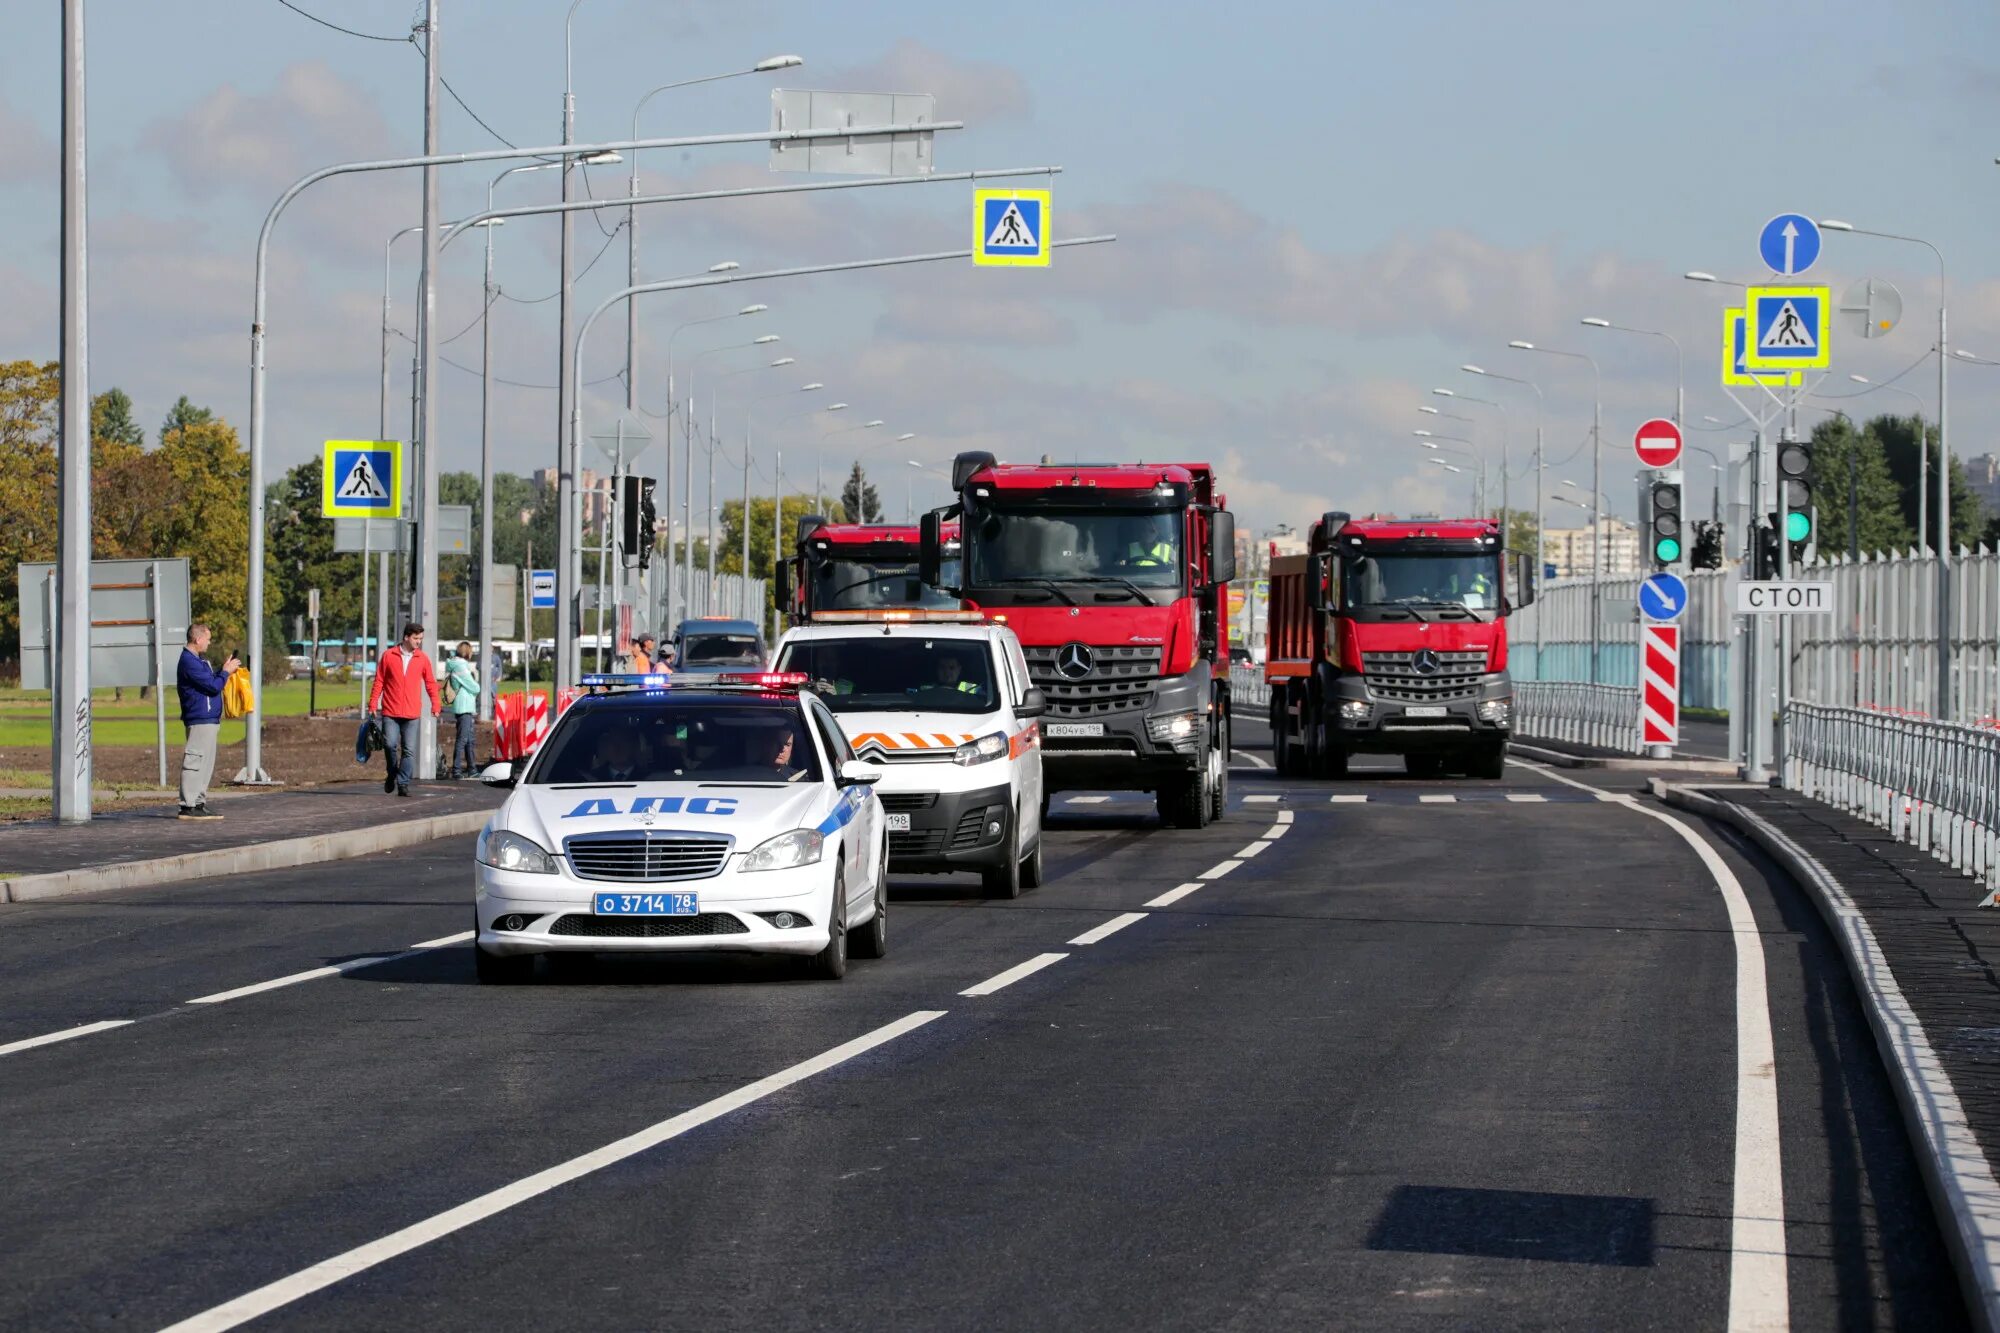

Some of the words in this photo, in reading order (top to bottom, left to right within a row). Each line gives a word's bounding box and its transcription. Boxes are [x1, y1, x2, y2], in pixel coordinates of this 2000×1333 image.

[1749, 588, 1821, 607] СТОП
[561, 797, 738, 818] ДПС
[888, 815, 907, 825] 198
[621, 895, 664, 912] 3714
[674, 895, 691, 908] 78
